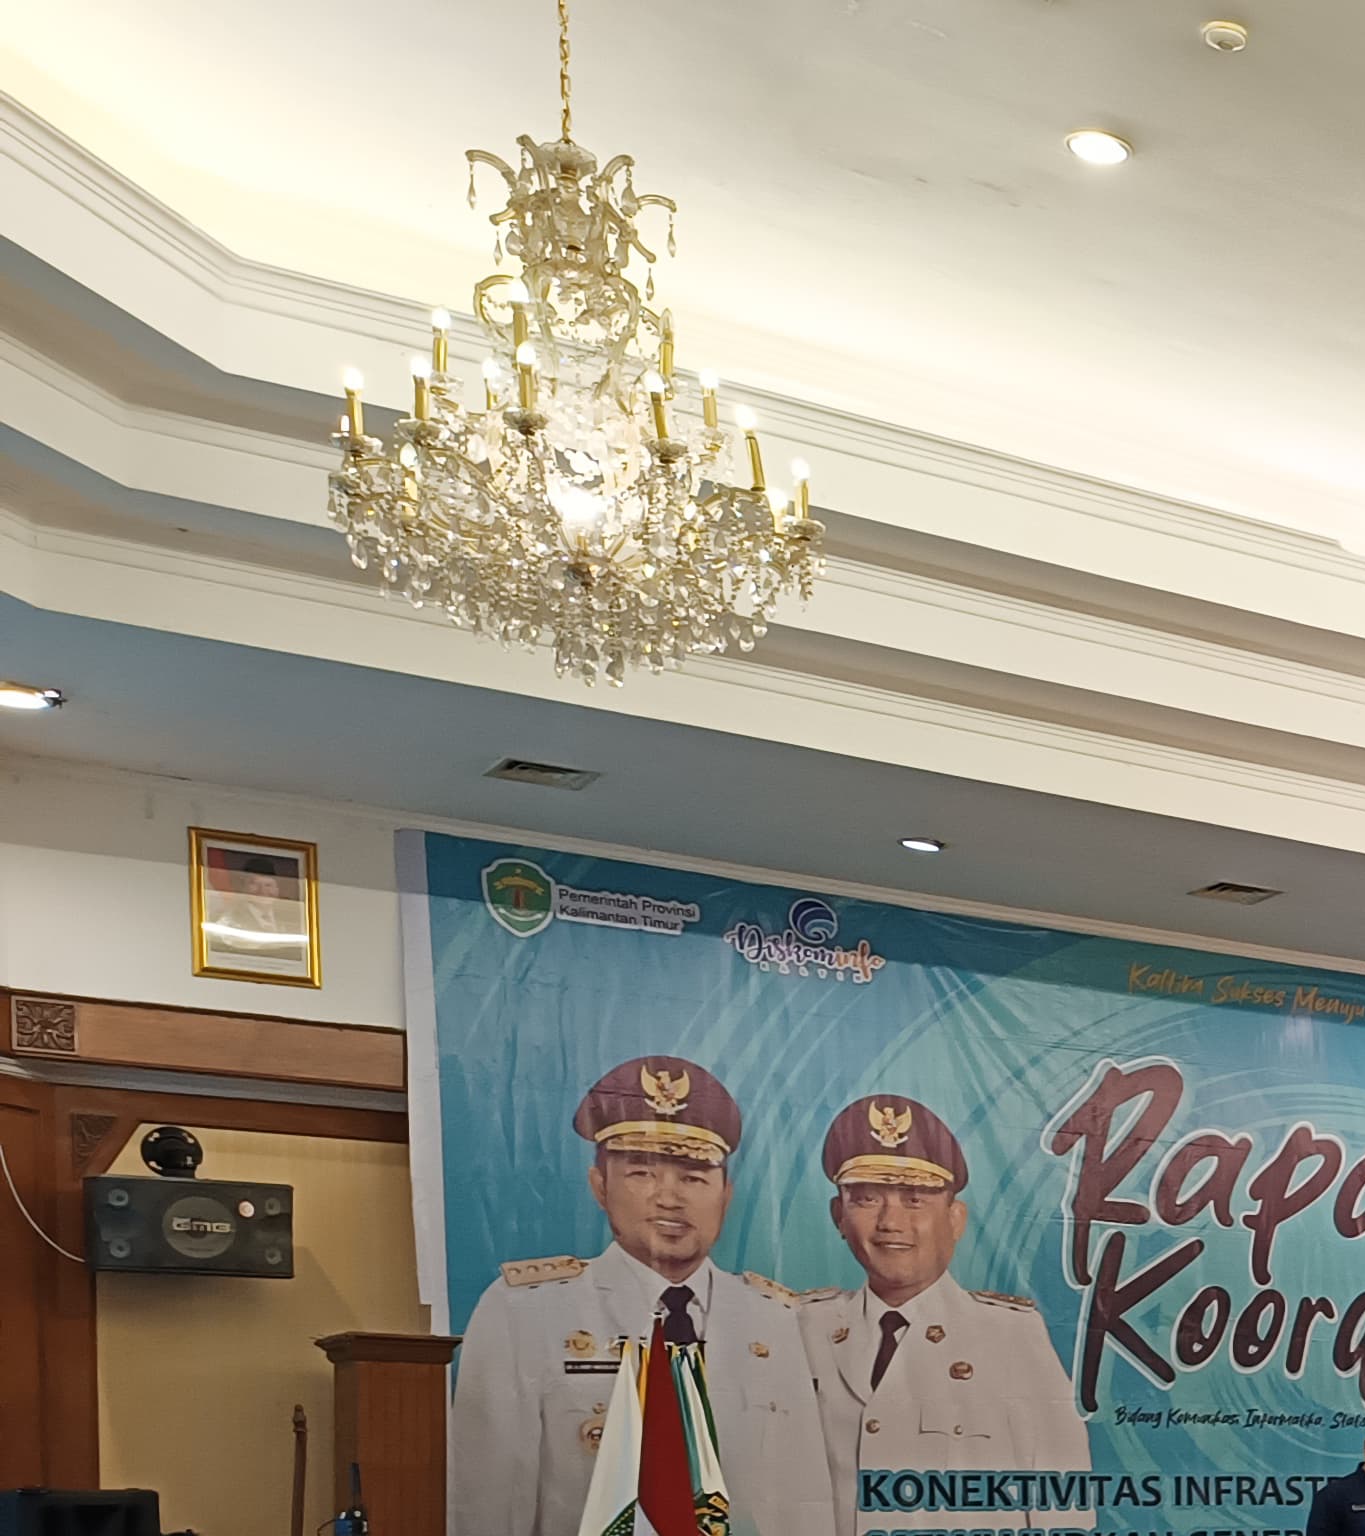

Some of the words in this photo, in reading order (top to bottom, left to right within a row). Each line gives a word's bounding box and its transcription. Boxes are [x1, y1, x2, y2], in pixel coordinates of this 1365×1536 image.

[559, 889, 638, 910] Pemerintah
[642, 900, 696, 917] Provinsi
[560, 905, 638, 925] Kalimantan
[641, 915, 679, 930] Timur
[1212, 976, 1283, 1006] Sukses
[1294, 987, 1365, 1024] Menuju
[862, 1475, 1161, 1508] KONEKTIVITAS
